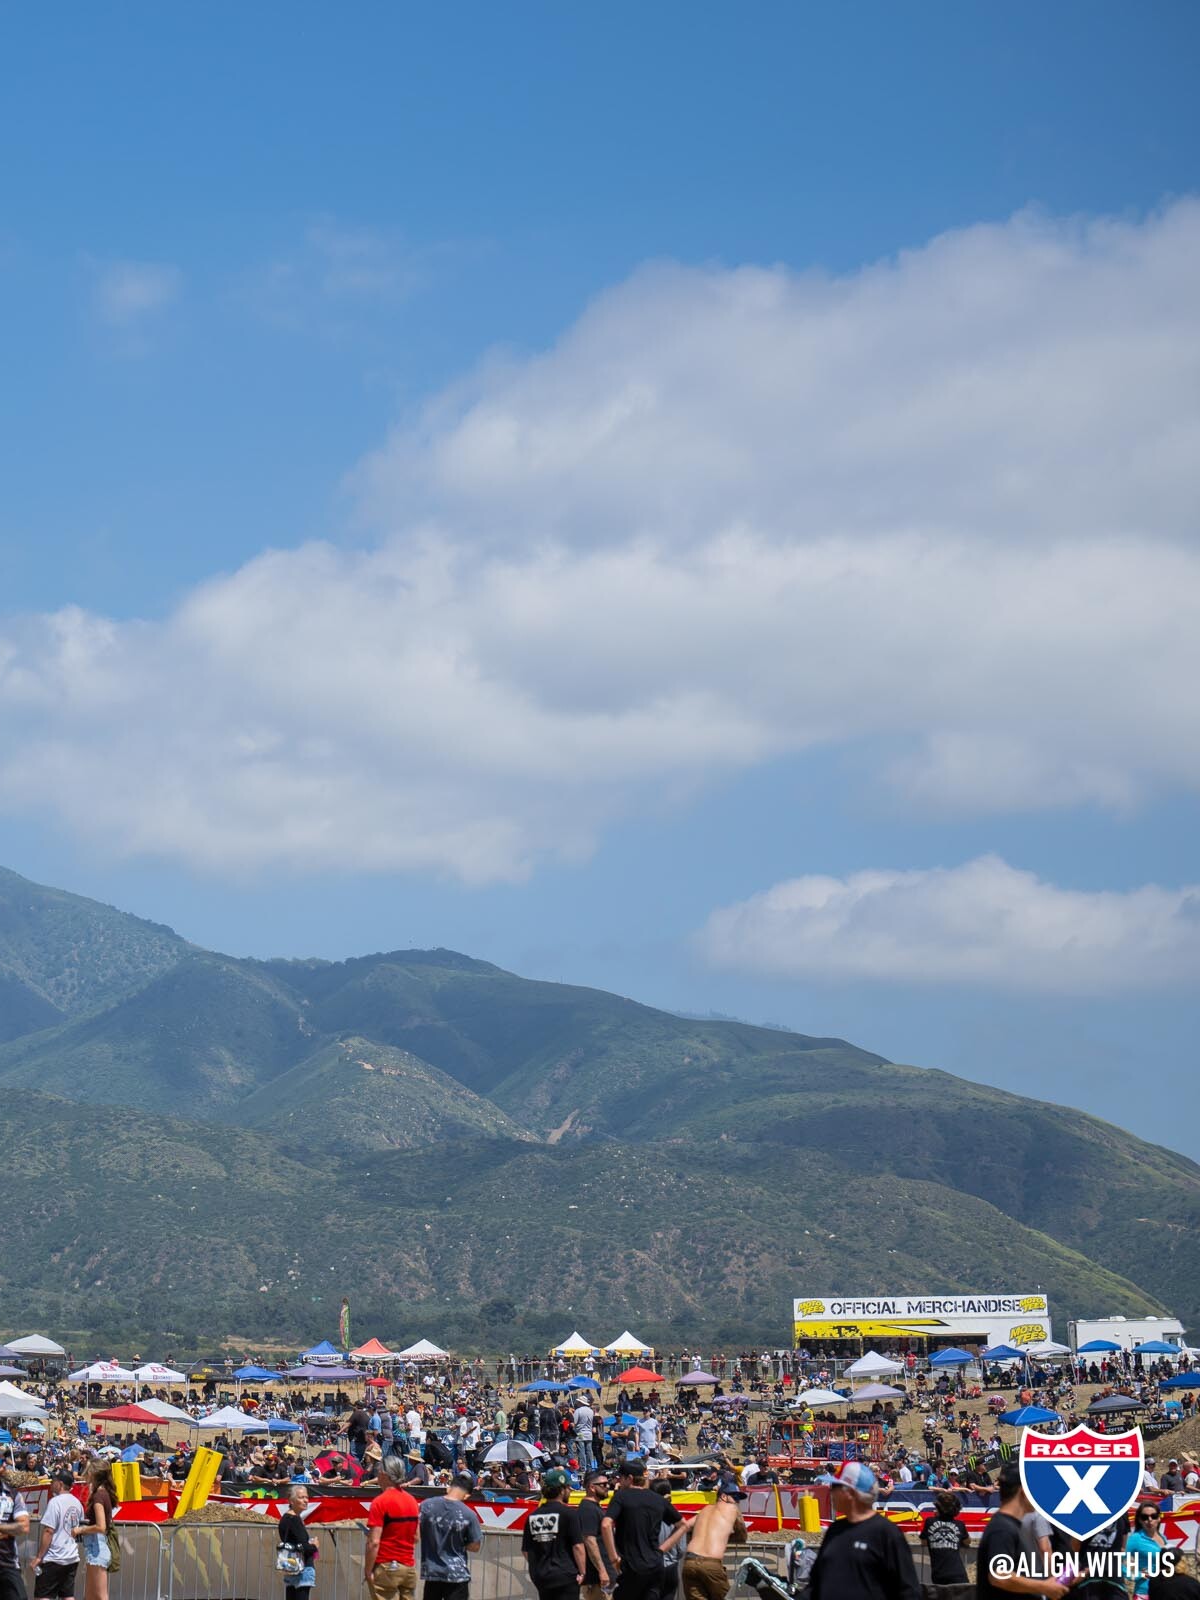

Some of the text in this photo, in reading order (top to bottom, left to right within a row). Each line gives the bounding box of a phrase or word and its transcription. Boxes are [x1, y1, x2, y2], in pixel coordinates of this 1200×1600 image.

[830, 1299, 1021, 1314] OFFICIAL MERCHANDISE
[1010, 1324, 1043, 1340] MOTO
[1016, 1330, 1047, 1348] TEES
